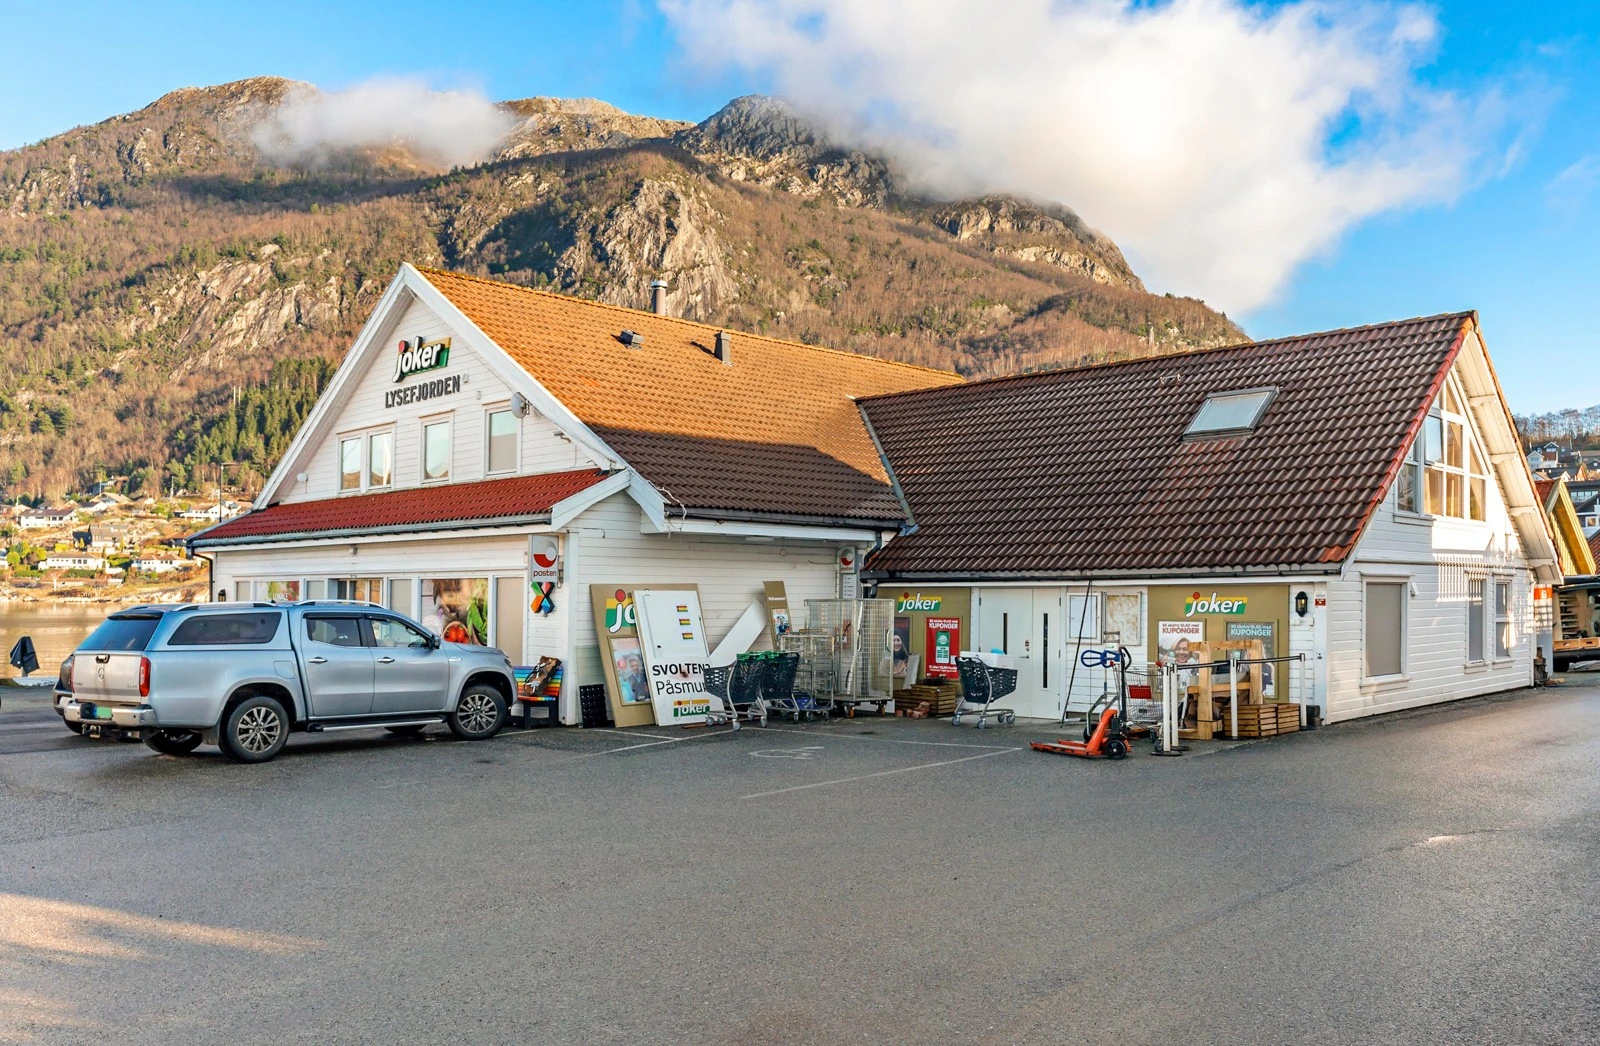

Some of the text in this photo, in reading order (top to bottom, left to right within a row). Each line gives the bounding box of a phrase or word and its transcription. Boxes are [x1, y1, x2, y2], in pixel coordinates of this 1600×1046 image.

[392, 336, 443, 383] joker
[385, 375, 460, 408] LYSEFJORDEN
[533, 569, 557, 577] posten
[609, 589, 640, 633] jo
[898, 592, 938, 614] joker
[1185, 591, 1243, 617] joker
[1162, 627, 1200, 635] KUPONGER
[1231, 629, 1271, 637] KUPONGER
[674, 700, 707, 721] joker
